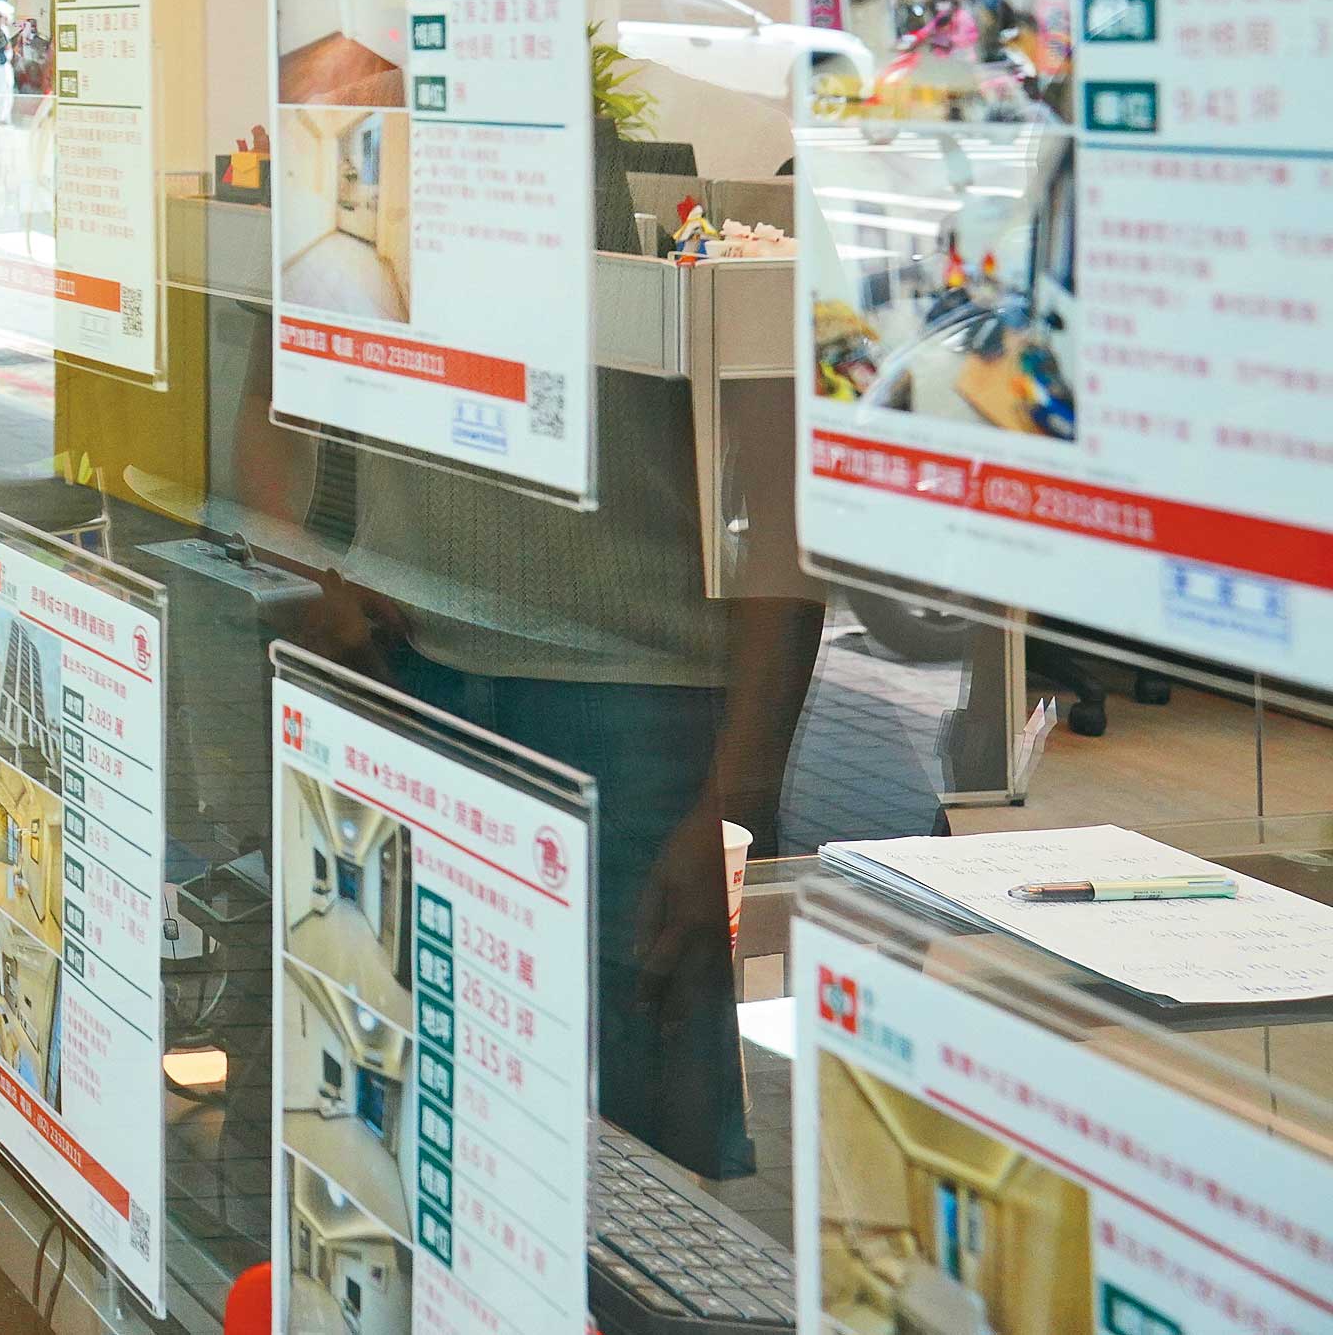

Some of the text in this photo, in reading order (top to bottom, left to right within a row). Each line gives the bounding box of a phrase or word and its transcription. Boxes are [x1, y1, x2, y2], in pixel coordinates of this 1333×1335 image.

[459, 915, 509, 976] 3,238
[460, 968, 509, 1032] 26.23
[461, 1023, 501, 1079] 3.15
[36, 1106, 49, 1138] (02)
[49, 1119, 81, 1170] 23318111
